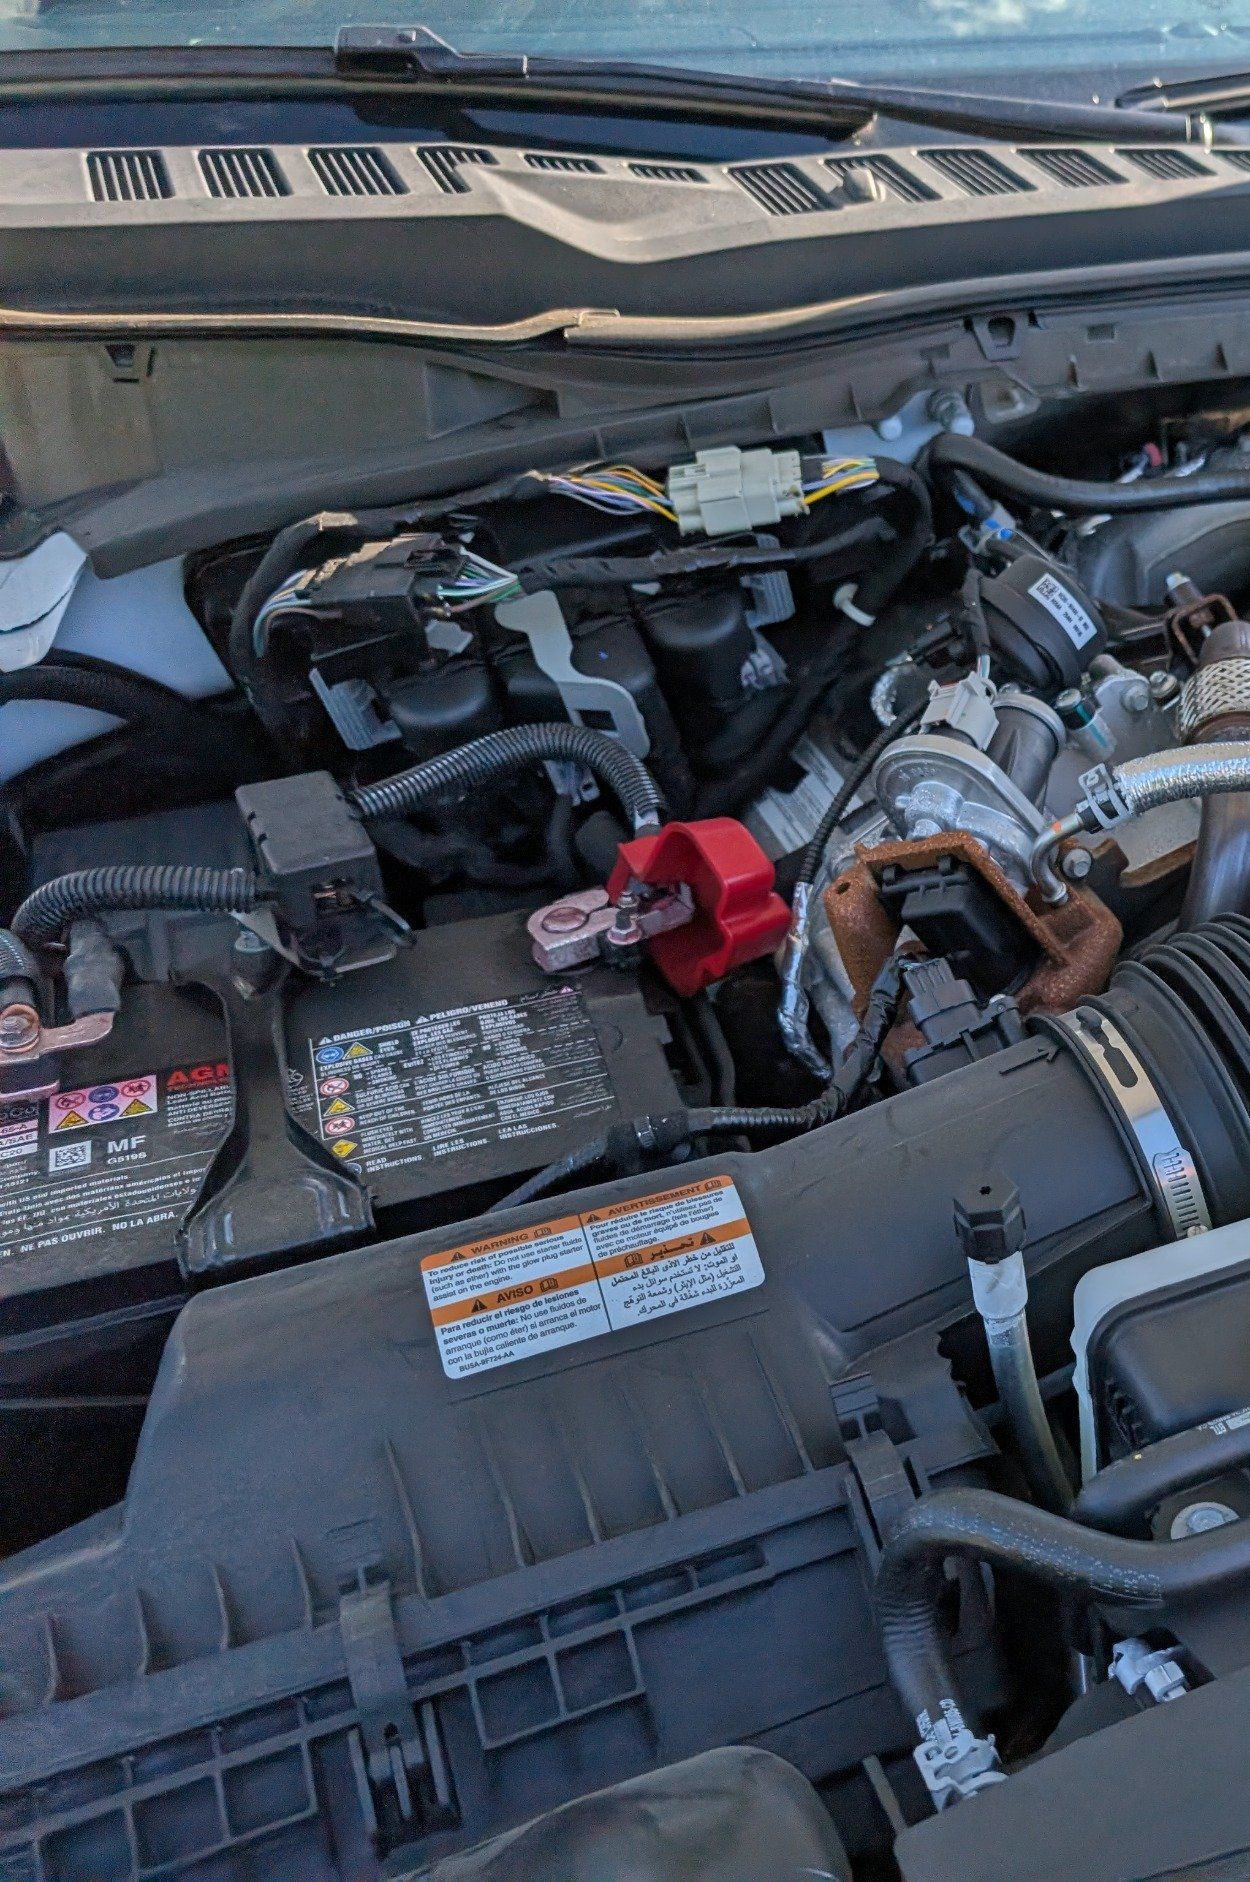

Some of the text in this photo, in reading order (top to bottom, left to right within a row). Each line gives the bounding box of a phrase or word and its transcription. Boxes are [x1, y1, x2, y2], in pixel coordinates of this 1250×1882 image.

[429, 998, 507, 1021] PELIGRO/VENENO
[333, 1019, 410, 1042] DANGER/POISON
[107, 1134, 147, 1154] MF
[500, 1121, 559, 1141] INSTRUCCIONES.
[366, 1157, 386, 1166] READ
[367, 1154, 423, 1173] INSTRUCTIONS.
[590, 1222, 608, 1231] Pour
[611, 1213, 638, 1225] réduire
[649, 1203, 673, 1215] risque
[686, 1189, 723, 1203] blessures
[607, 1185, 702, 1216] AVERTISSEMENT
[37, 1237, 58, 1248] PAS
[61, 1226, 105, 1243] OUVRIR.
[112, 1222, 127, 1231] NO
[130, 1218, 144, 1227] LA
[146, 1211, 178, 1224] ABRA.
[592, 1227, 619, 1238] graves
[593, 1233, 618, 1243] fluides
[631, 1218, 670, 1234] démarrage
[596, 1242, 614, 1250] avec
[626, 1230, 651, 1241] moteur
[653, 1222, 678, 1235] équipé
[690, 1210, 719, 1224] bougies
[441, 1262, 468, 1273] reduce
[470, 1257, 485, 1265] risk
[498, 1242, 536, 1258] possible
[538, 1235, 564, 1245] serious
[466, 1263, 492, 1274] death:
[536, 1243, 560, 1254] starter
[562, 1237, 582, 1246] fluids
[471, 1233, 529, 1255] WARNING
[609, 1235, 660, 1255] préchauffage.
[431, 1282, 453, 1294] (such
[466, 1272, 489, 1284] ether)
[491, 1267, 506, 1275] with
[522, 1257, 540, 1268] glow
[541, 1252, 558, 1262] plug
[559, 1245, 583, 1256] starter
[433, 1290, 456, 1301] assist
[484, 1274, 512, 1287] engine.
[496, 1285, 534, 1303] AVISO
[441, 1288, 579, 1335] Para reducir el riesgo de lesiones
[443, 1331, 477, 1346] severas
[486, 1317, 519, 1332] muerte:
[520, 1313, 532, 1322] No
[534, 1309, 548, 1318] use
[550, 1300, 575, 1313] fluidos
[576, 1296, 586, 1304] de
[446, 1302, 601, 1357] arranque (como éter) si arranca el motor
[448, 1357, 463, 1366] con
[465, 1352, 472, 1360] la
[495, 1335, 526, 1350] caliente
[527, 1331, 538, 1340] de
[540, 1321, 577, 1338] arranque.
